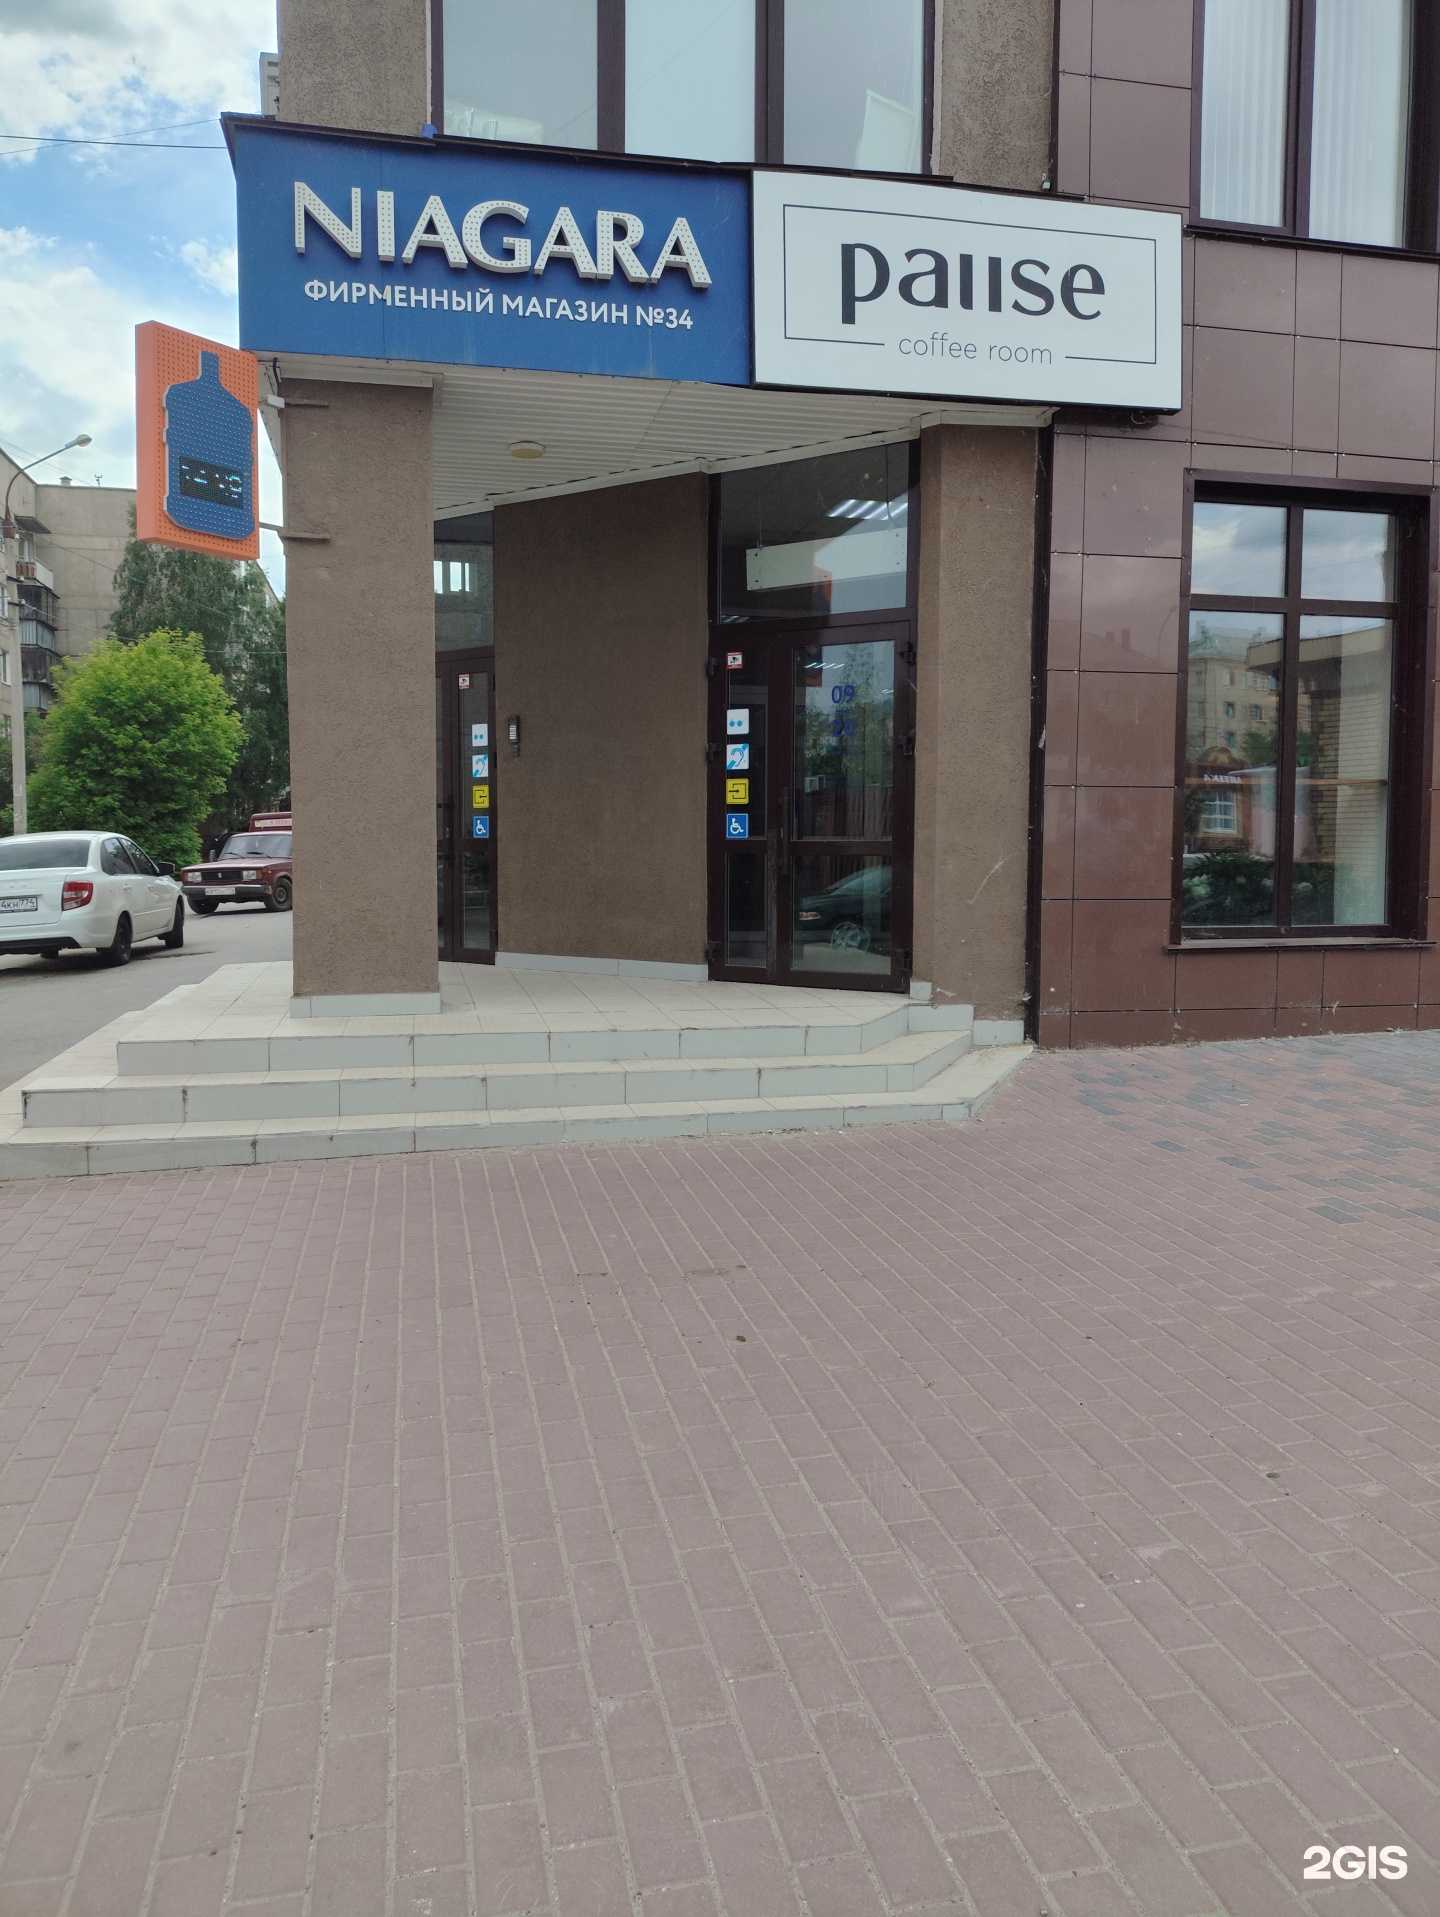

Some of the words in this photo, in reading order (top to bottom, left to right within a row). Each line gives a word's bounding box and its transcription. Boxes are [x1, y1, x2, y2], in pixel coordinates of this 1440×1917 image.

[294, 181, 712, 288] NIAGARA
[303, 279, 495, 314] ФИРМЕННЫЙ
[501, 294, 628, 326] МАГАЗИН
[635, 305, 695, 330] №34
[840, 243, 1106, 325] pause
[898, 332, 978, 360] coffee
[988, 342, 1053, 366] room
